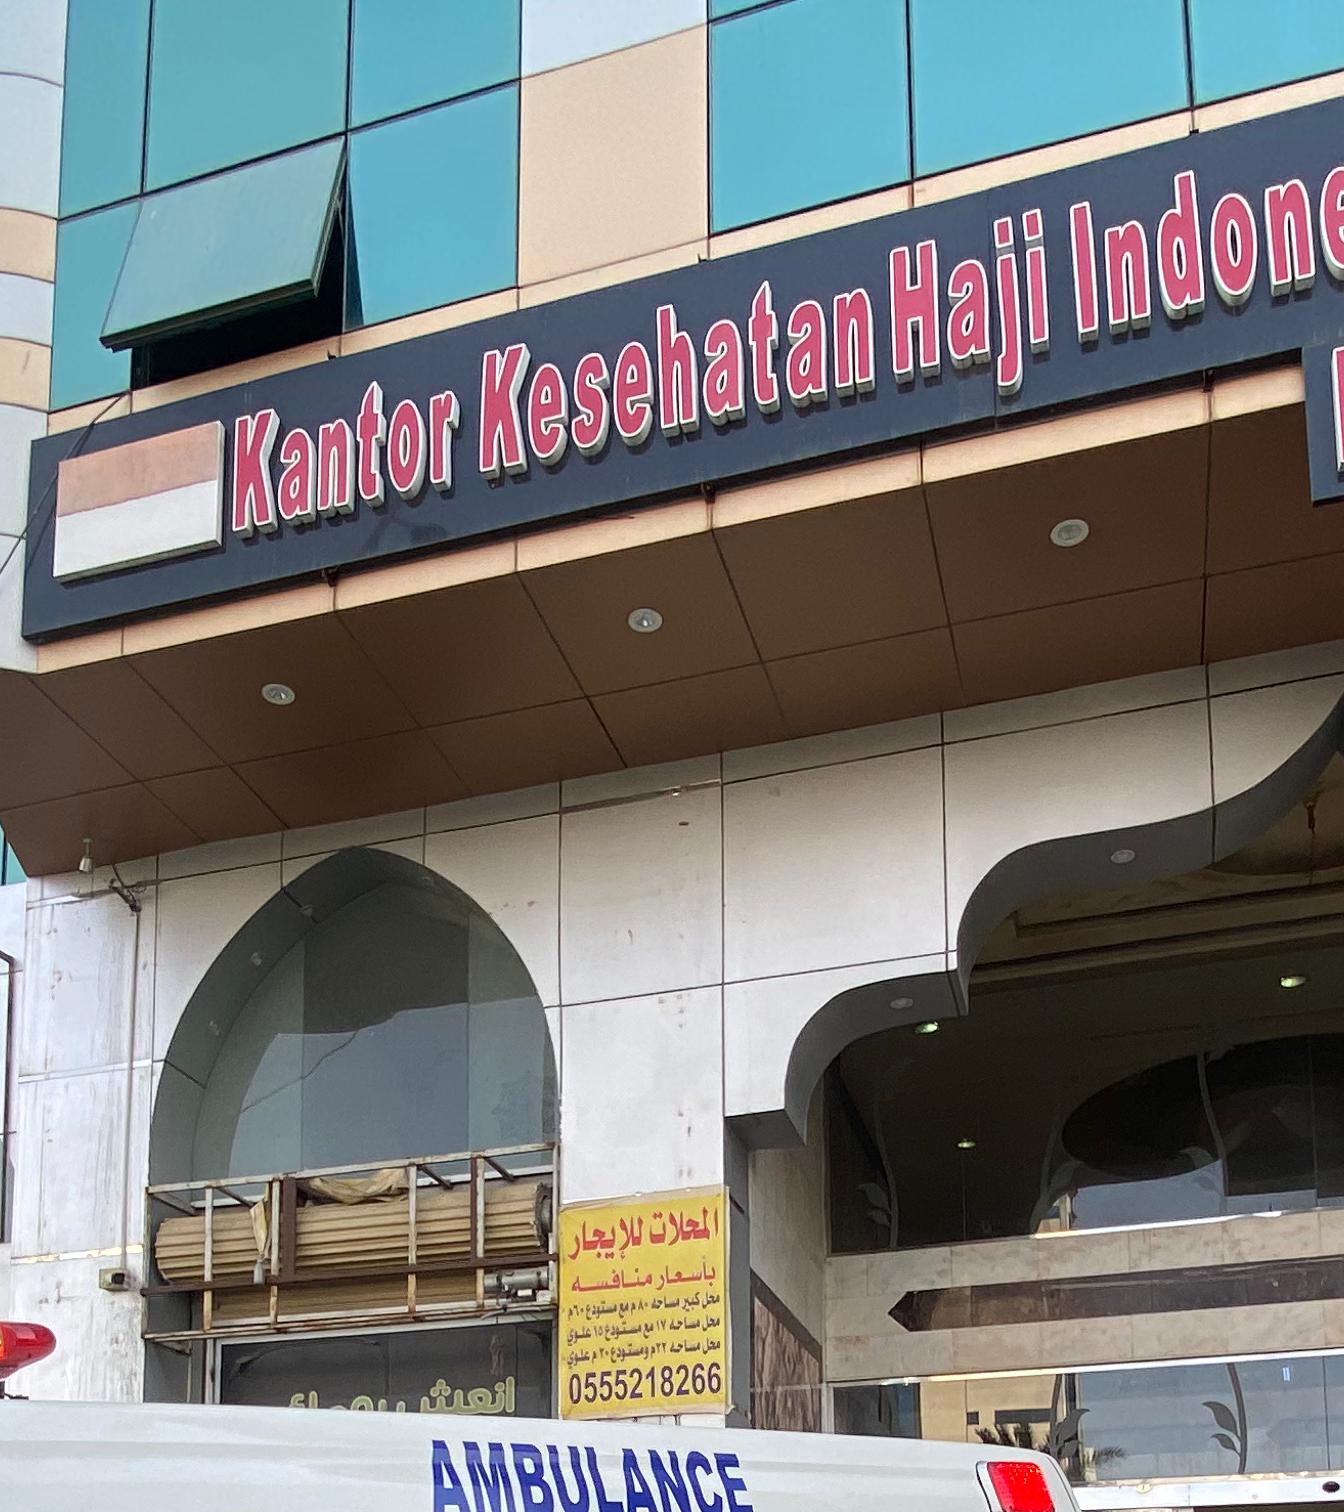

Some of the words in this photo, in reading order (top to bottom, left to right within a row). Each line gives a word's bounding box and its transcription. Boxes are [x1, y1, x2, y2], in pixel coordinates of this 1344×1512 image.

[231, 381, 458, 536] Kantor
[478, 279, 875, 480] Kesehatan
[888, 209, 1050, 396] Haji
[568, 1215, 644, 1260] للإيجار
[649, 1206, 719, 1246] المحلات
[656, 1256, 716, 1290] بأسعار
[702, 1291, 720, 1309] محل
[702, 1314, 720, 1332] محل
[702, 1337, 721, 1355] محل
[568, 1362, 721, 1404] 0555218266
